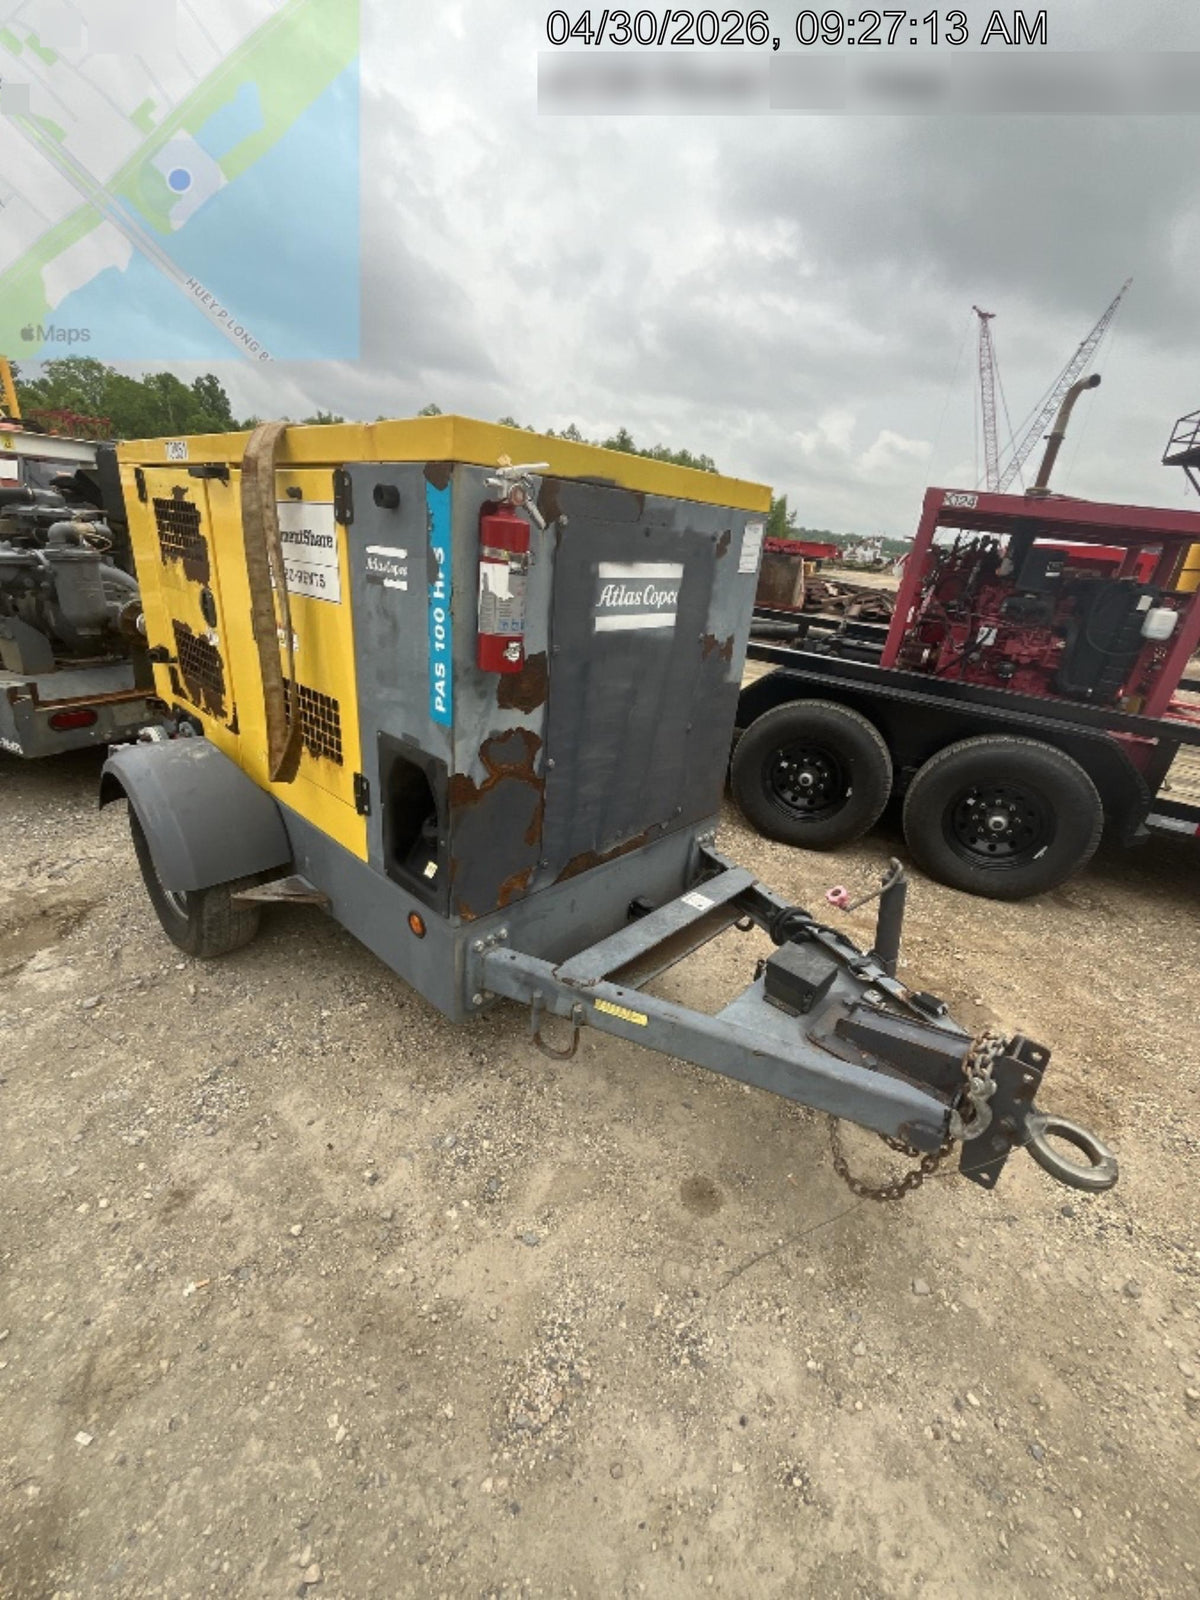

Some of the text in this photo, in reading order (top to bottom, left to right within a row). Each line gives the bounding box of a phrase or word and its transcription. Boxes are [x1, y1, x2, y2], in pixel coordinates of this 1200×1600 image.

[595, 583, 642, 608] Atlas
[433, 607, 445, 652] 100
[434, 662, 446, 713] PAS
